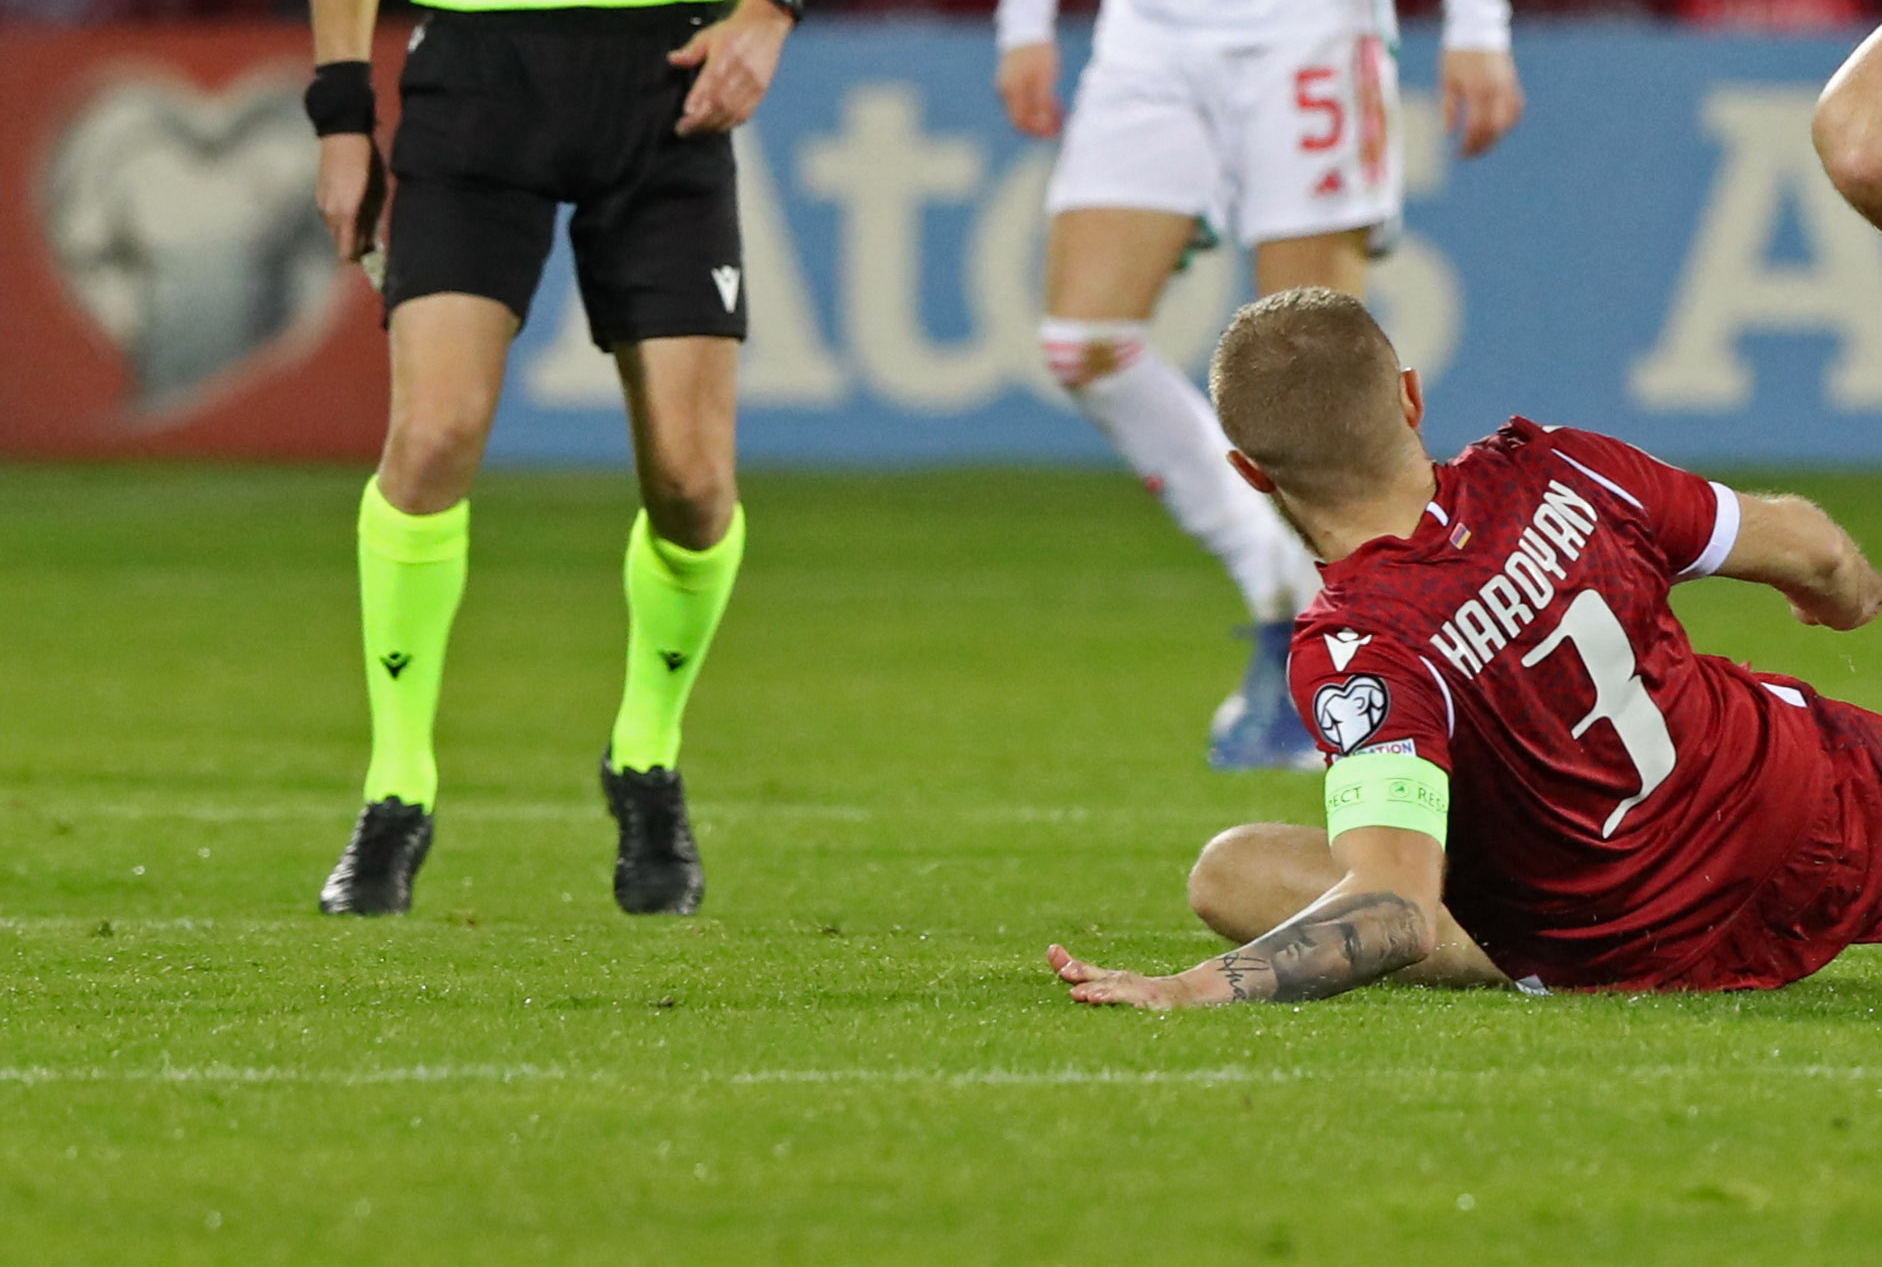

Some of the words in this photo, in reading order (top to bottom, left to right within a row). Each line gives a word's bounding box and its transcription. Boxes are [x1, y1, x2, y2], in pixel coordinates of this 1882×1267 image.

[1295, 66, 1344, 154] 5
[1429, 478, 1597, 681] HAROYAN
[1520, 588, 1677, 840] 3
